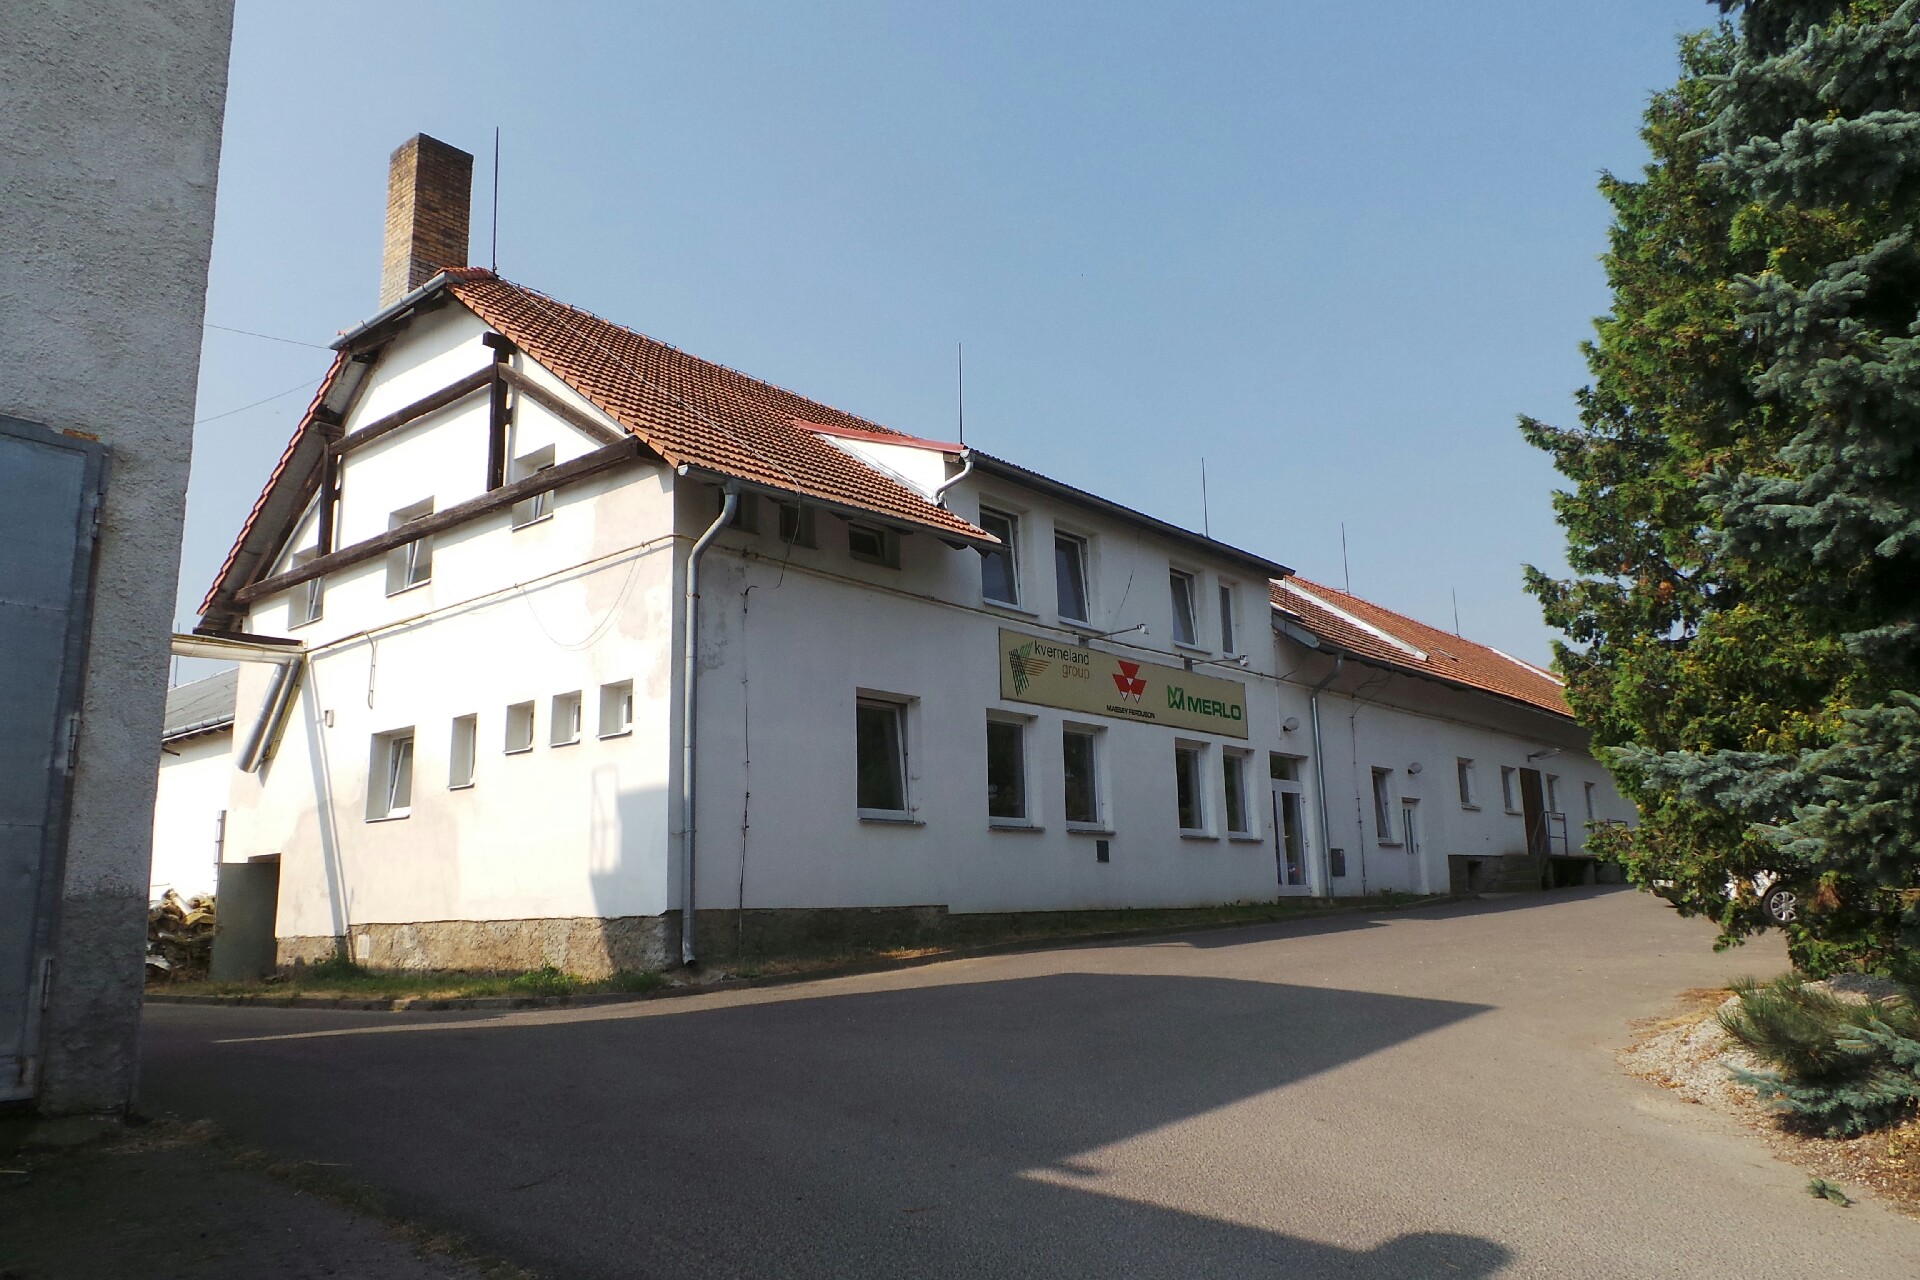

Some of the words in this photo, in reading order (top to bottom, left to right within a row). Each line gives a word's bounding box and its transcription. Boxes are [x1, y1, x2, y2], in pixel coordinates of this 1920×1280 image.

[1034, 640, 1090, 665] kverneland
[1062, 663, 1090, 680] group
[1106, 704, 1129, 714] MASSEY
[1128, 709, 1155, 719] FERGUSON
[1187, 696, 1241, 721] MERLO
